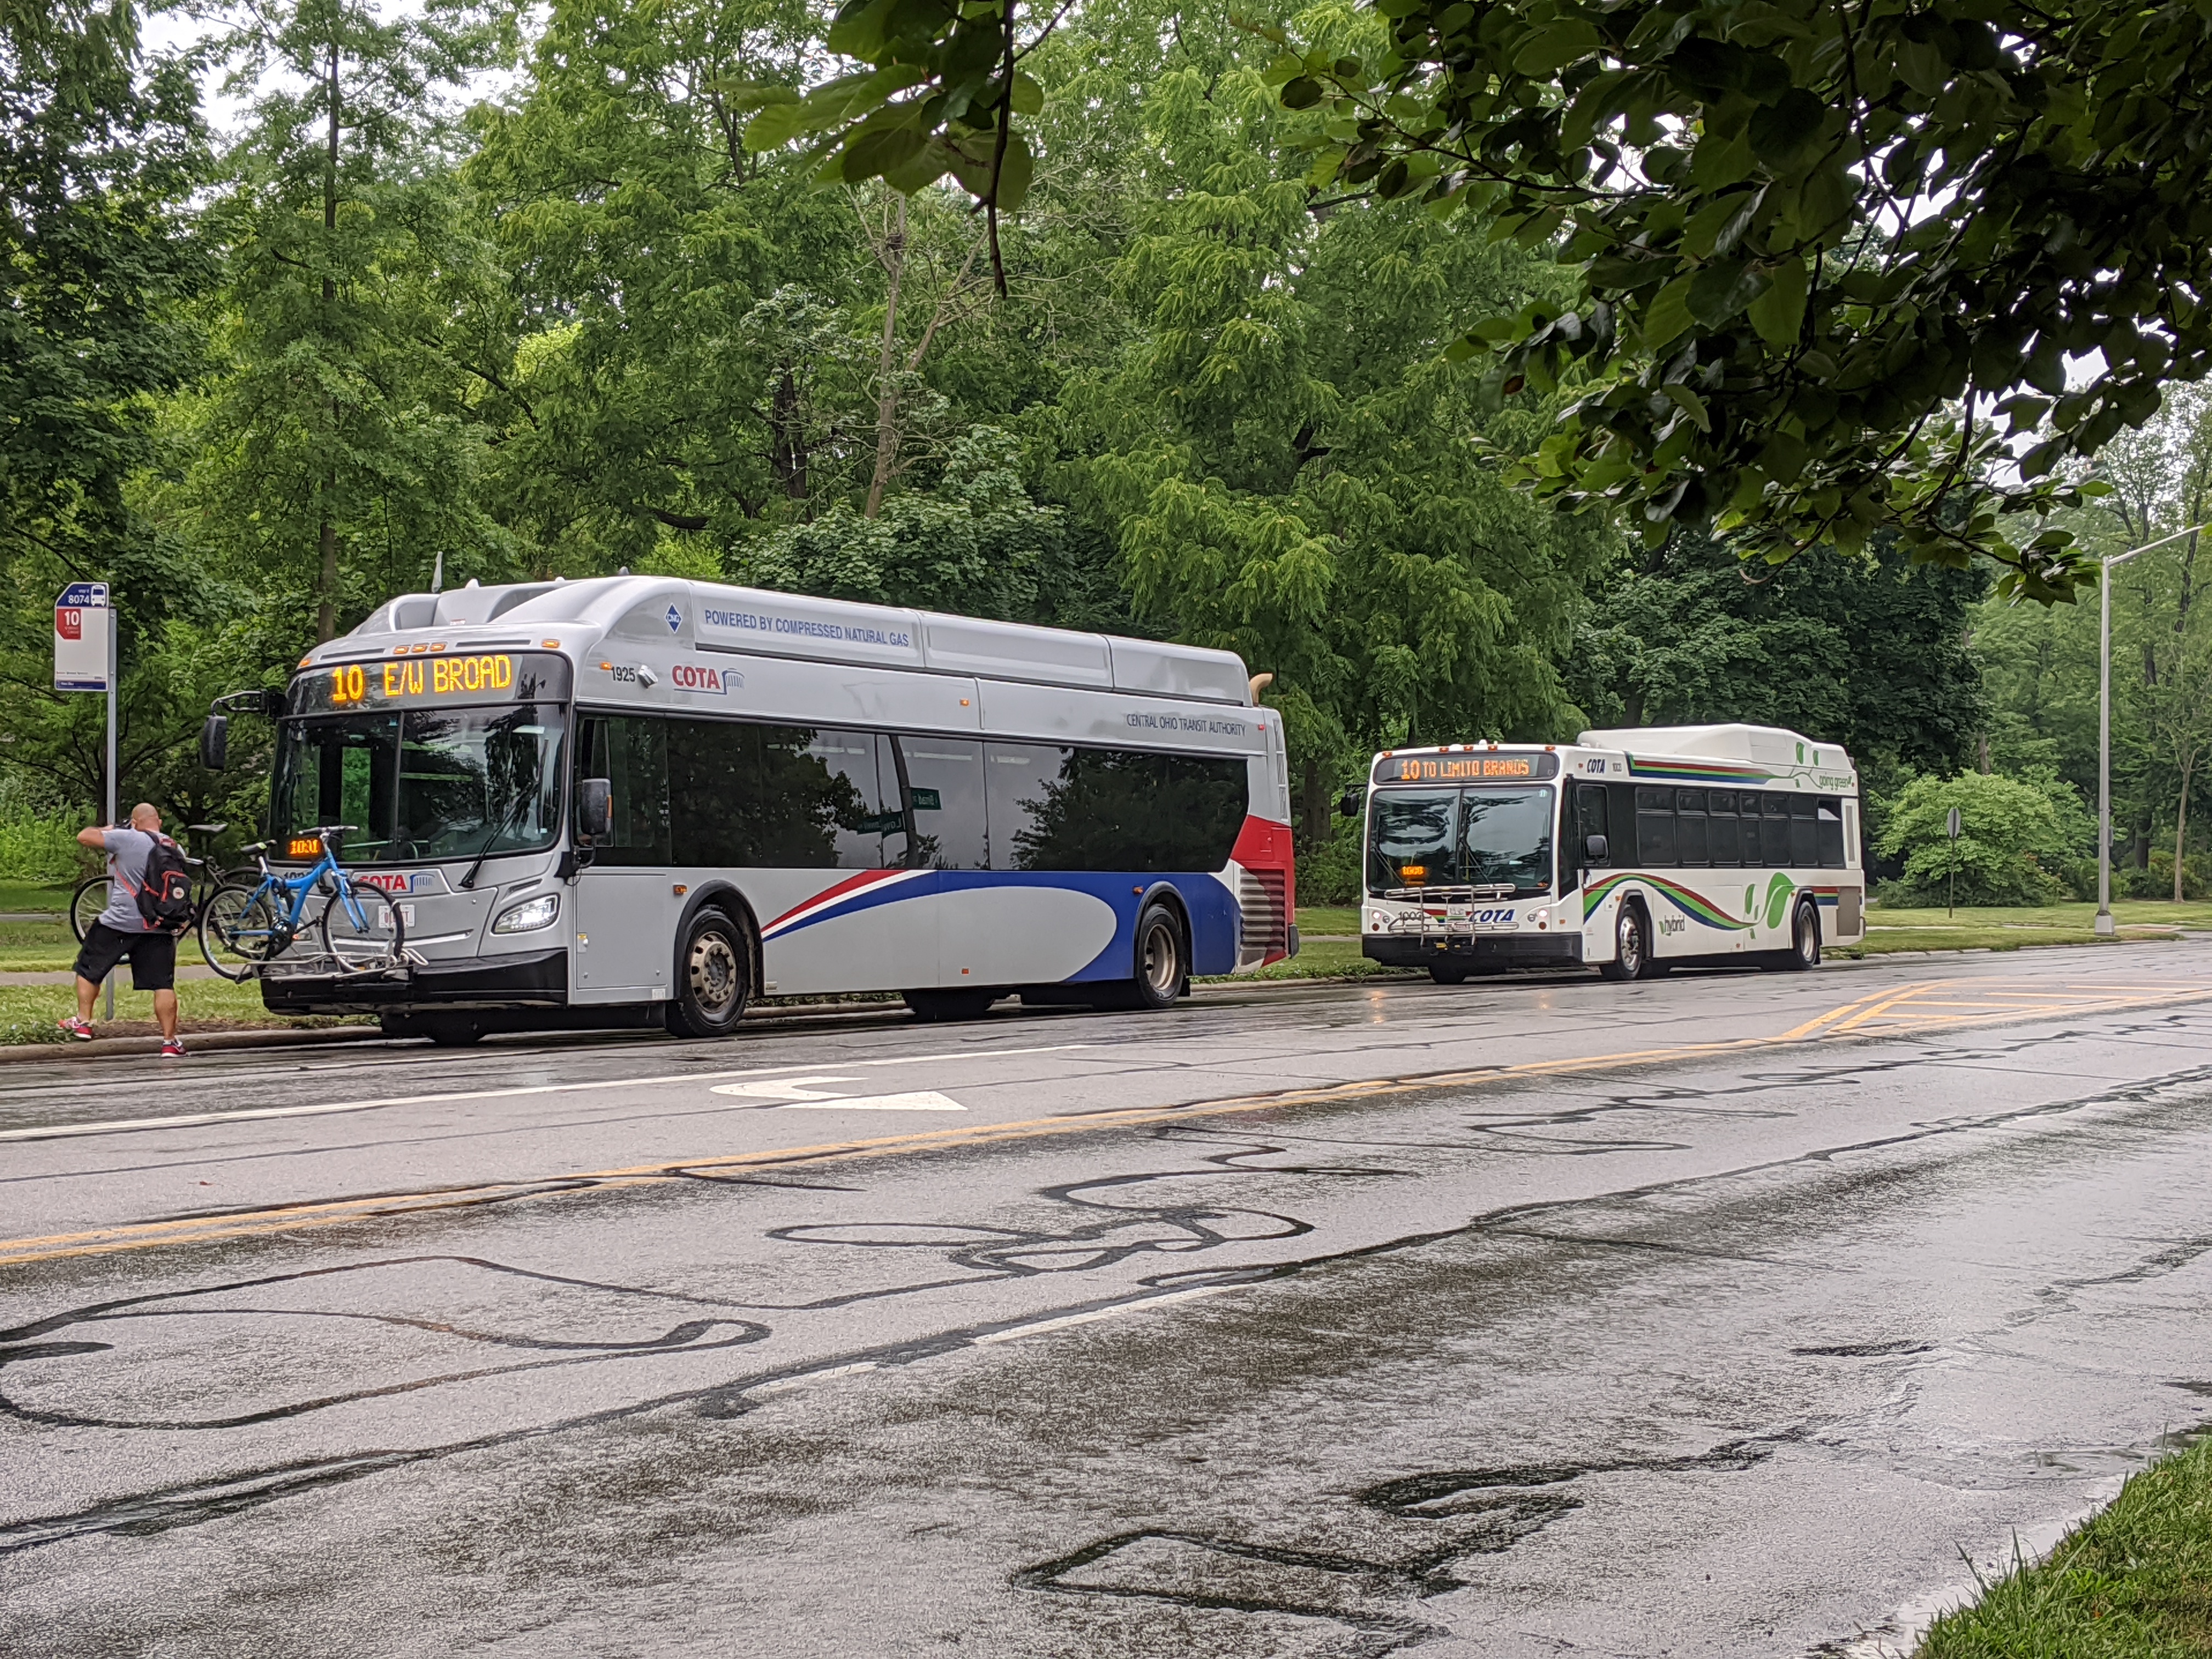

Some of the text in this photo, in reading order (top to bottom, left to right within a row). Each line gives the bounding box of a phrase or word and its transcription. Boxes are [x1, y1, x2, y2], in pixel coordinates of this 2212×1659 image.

[67, 595, 89, 604] 8074
[64, 611, 80, 626] 10
[704, 610, 909, 647] POWERED BY COMPRESSED NATURAL GAS
[332, 654, 511, 702] 10 E/W BROAD
[611, 666, 636, 682] 1925
[672, 665, 721, 689] COTA
[1126, 714, 1246, 737] CENTRAL OHIO TRANSIT AUTHORITY
[1401, 759, 1420, 780] 10
[1422, 760, 1437, 778] TO
[1587, 759, 1605, 774] COTA
[1819, 771, 1833, 791] going
[1469, 909, 1515, 922] COTA
[1664, 915, 1685, 936] hybrid
